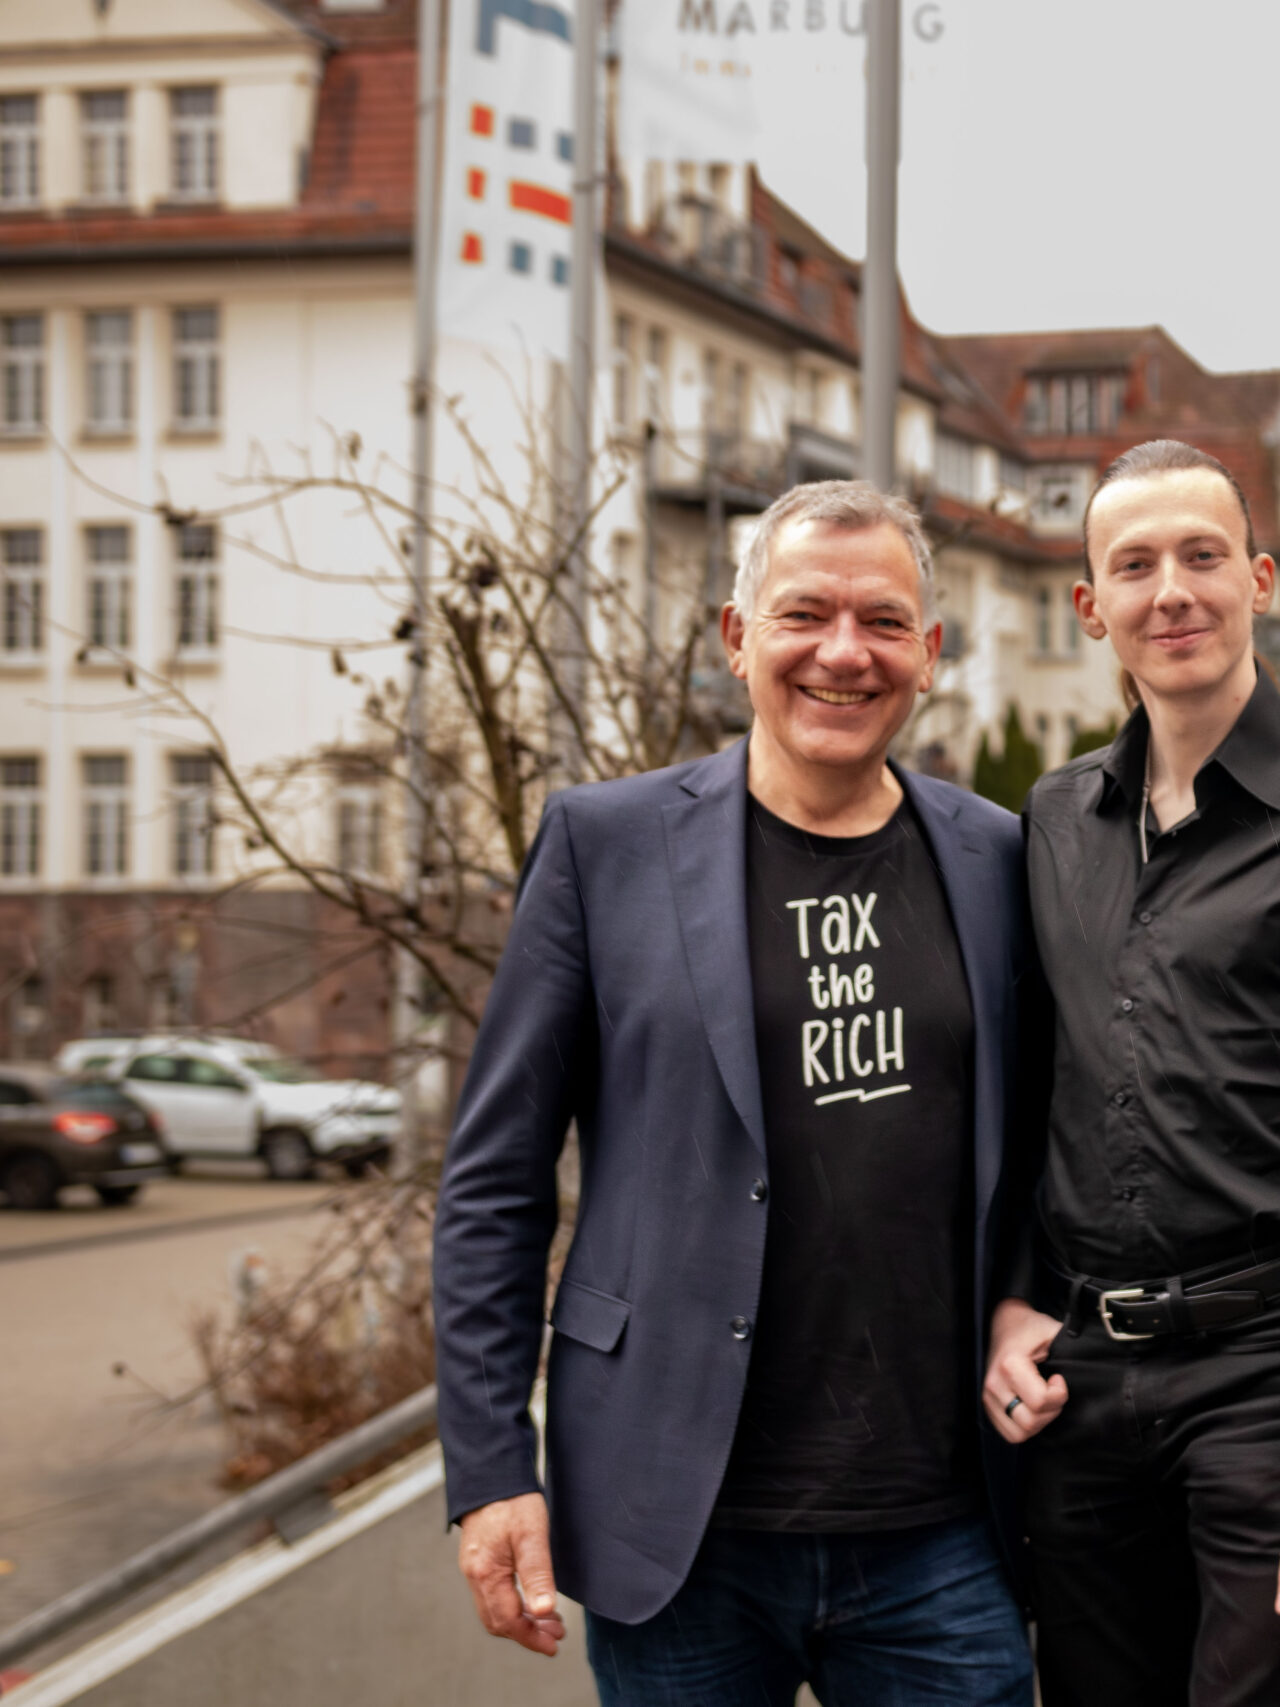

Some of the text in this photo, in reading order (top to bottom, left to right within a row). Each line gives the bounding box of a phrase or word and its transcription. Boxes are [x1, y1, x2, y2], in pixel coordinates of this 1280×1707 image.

[677, 0, 946, 43] MARBUG
[785, 892, 881, 959] Tax
[807, 962, 875, 1010] the
